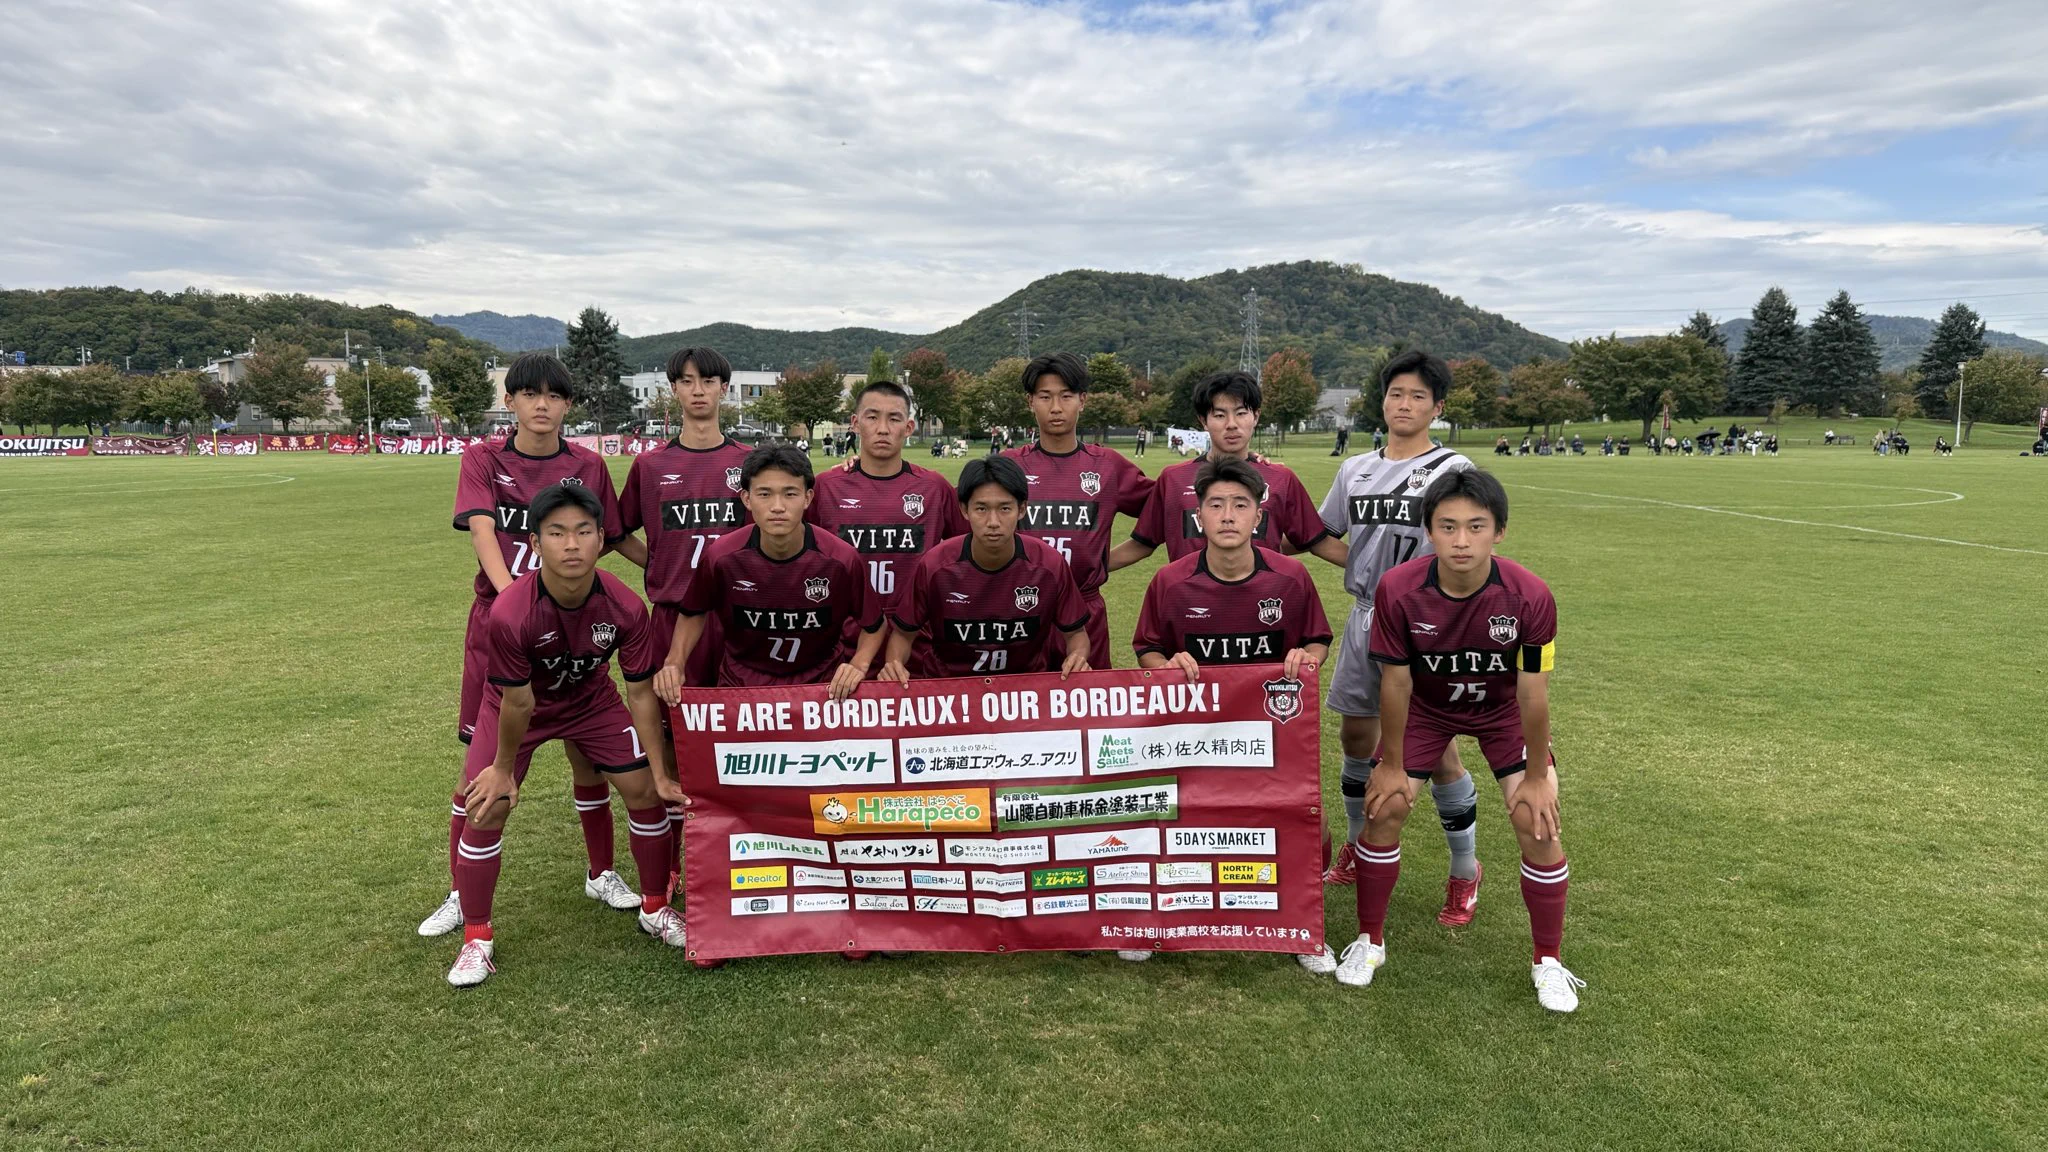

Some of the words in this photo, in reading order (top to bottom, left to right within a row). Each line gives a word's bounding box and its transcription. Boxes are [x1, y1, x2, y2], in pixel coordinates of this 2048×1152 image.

[499, 505, 528, 531] VI
[672, 502, 736, 525] VITA
[1026, 505, 1091, 527] VITA
[1355, 499, 1411, 522] VITA
[848, 528, 916, 550] VITA
[868, 560, 895, 594] 16
[744, 610, 822, 630] VITA
[954, 621, 1029, 642] VITA
[767, 636, 802, 664] 27
[1197, 635, 1272, 659] VITA
[972, 649, 1008, 672] 28
[1423, 651, 1507, 673] VITA
[681, 703, 727, 732] WE
[737, 701, 793, 732] ARE
[802, 694, 970, 730] BORDEAUX!
[981, 690, 1039, 723] OUR
[1050, 683, 1221, 719] BORDEAUX!
[1102, 734, 1132, 746] Meat
[1096, 756, 1129, 769] Saku!
[1099, 746, 1135, 758] Meets
[723, 751, 888, 775] 旭川トヨペット
[883, 796, 925, 807] 株式会社
[1002, 793, 1040, 802] 有限会社
[857, 797, 981, 830] Harapeco
[753, 841, 825, 856] 旭川しんきん
[1088, 845, 1129, 855] YAMAtune
[747, 874, 782, 883] Realtor
[860, 897, 887, 908] Salon
[1044, 899, 1073, 909] 名鉄観光
[1101, 925, 1299, 939] 私たちは旭川実業高校を応援しています
